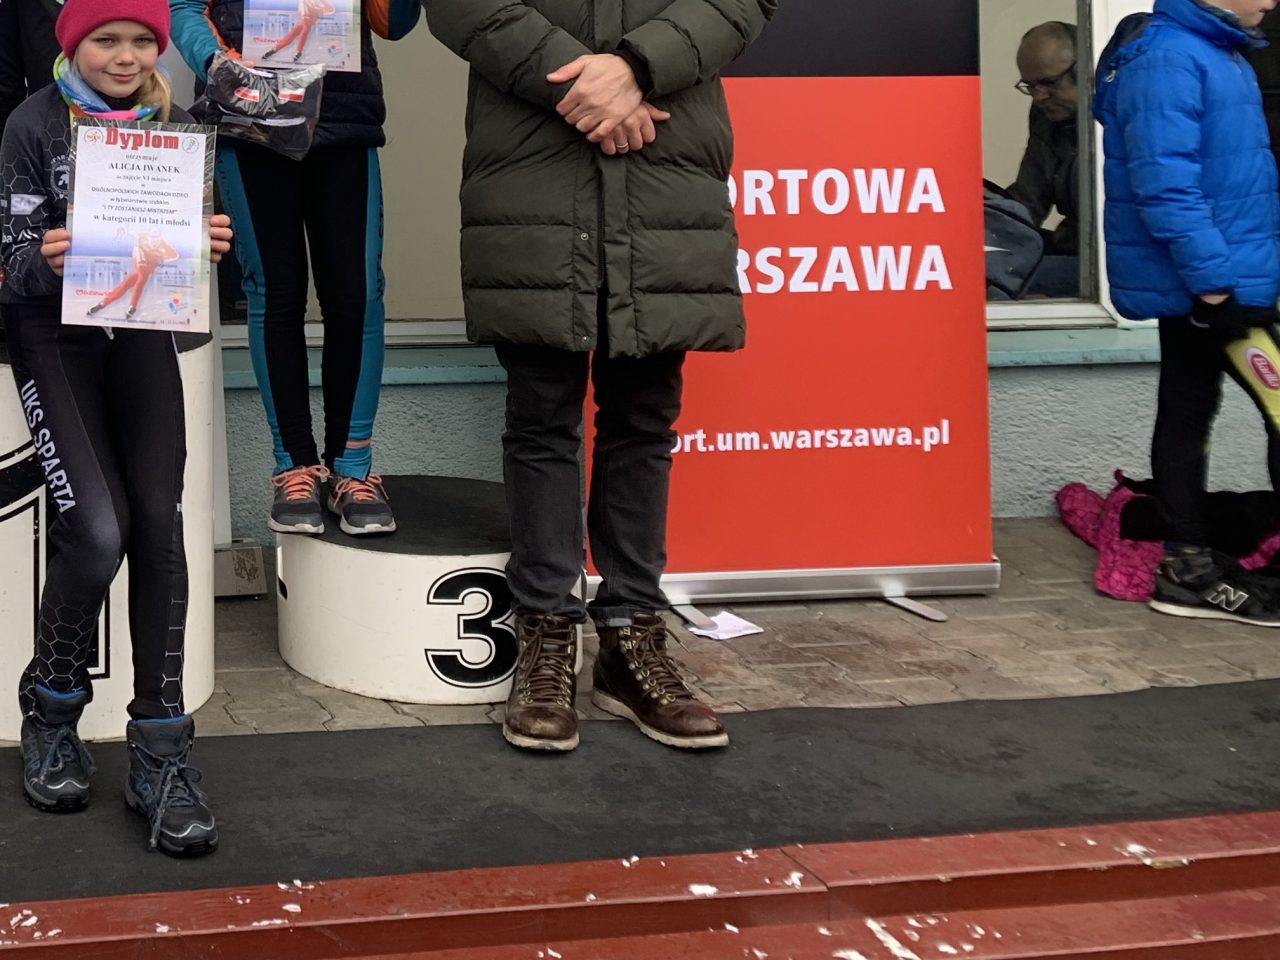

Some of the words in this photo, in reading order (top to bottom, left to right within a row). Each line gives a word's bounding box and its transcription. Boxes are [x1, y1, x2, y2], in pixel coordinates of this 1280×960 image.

[105, 127, 179, 150] Dyplom
[109, 162, 141, 171] ALICJA
[144, 164, 180, 173] IWANEK
[728, 168, 946, 215] RTOWA
[102, 214, 136, 224] kategorii
[737, 245, 953, 294] RSZAWA
[20, 379, 44, 429] UKS
[34, 428, 77, 514] SPARTA
[671, 420, 950, 454] rt.um.warszawa.pl
[424, 567, 519, 689] 3
